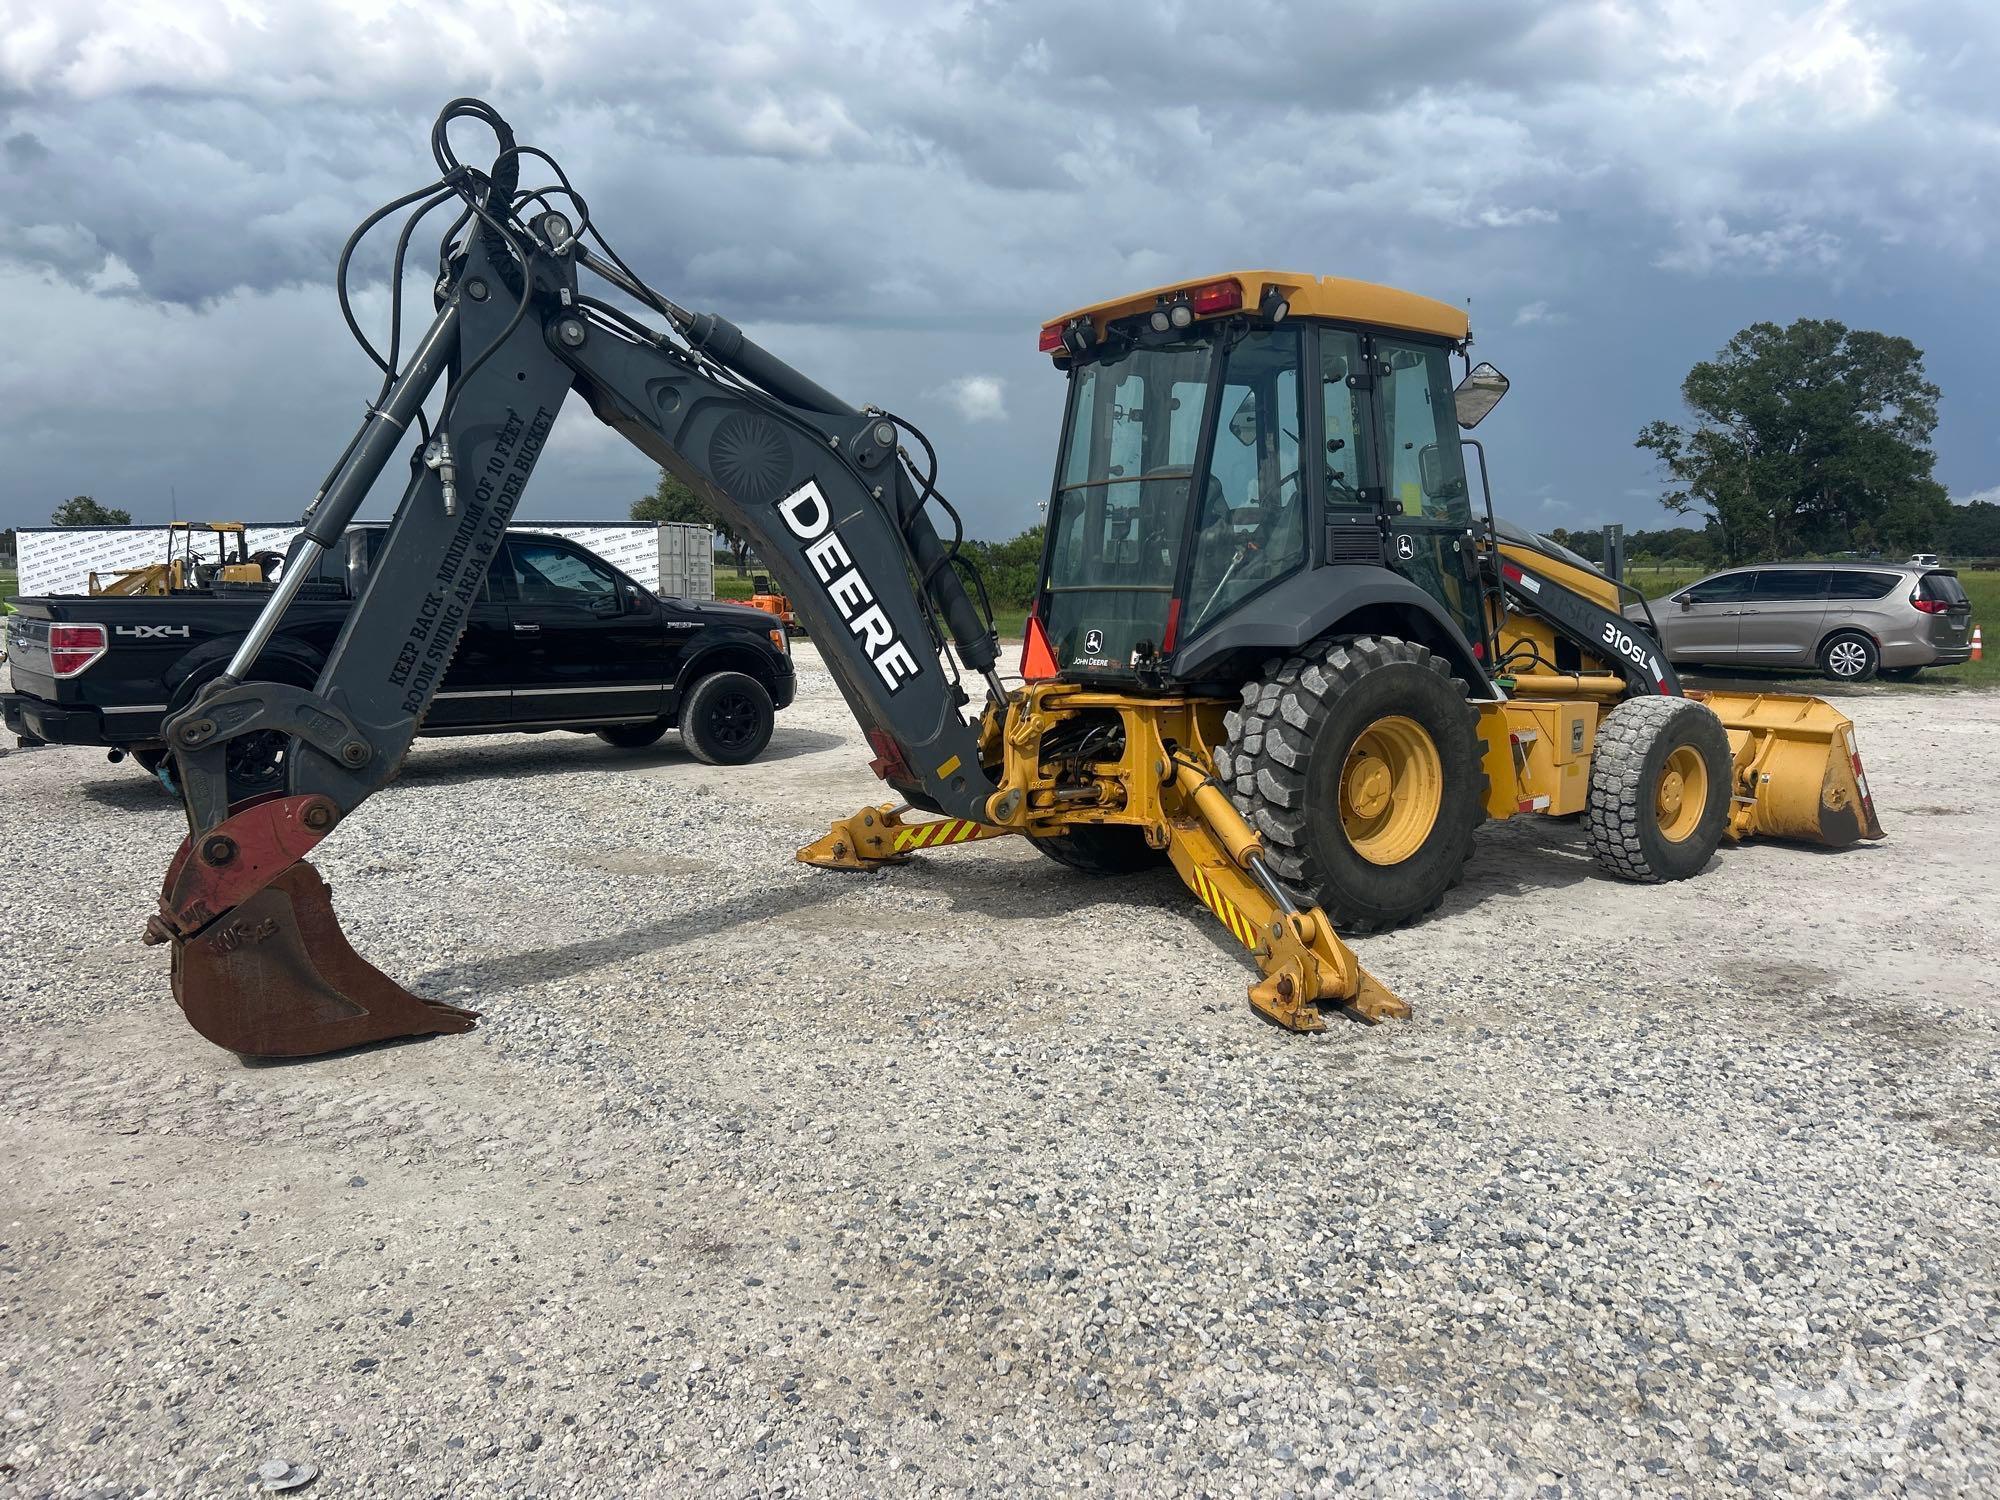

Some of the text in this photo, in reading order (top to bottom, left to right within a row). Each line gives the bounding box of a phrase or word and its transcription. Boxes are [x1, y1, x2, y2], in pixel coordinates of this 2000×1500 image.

[494, 412, 525, 458] FEET
[475, 476, 495, 503] OF
[486, 457, 504, 476] 10
[401, 406, 554, 715] BOOM SWING AREA & LOADER BUCKET
[436, 504, 484, 587] MINIMUM
[777, 480, 919, 692] DEERE
[115, 625, 190, 638] 4X4
[410, 596, 443, 644] BACK
[388, 642, 420, 688] KEEP
[1073, 657, 1108, 666] JOHN DEERE
[1601, 622, 1648, 670] 310SL
